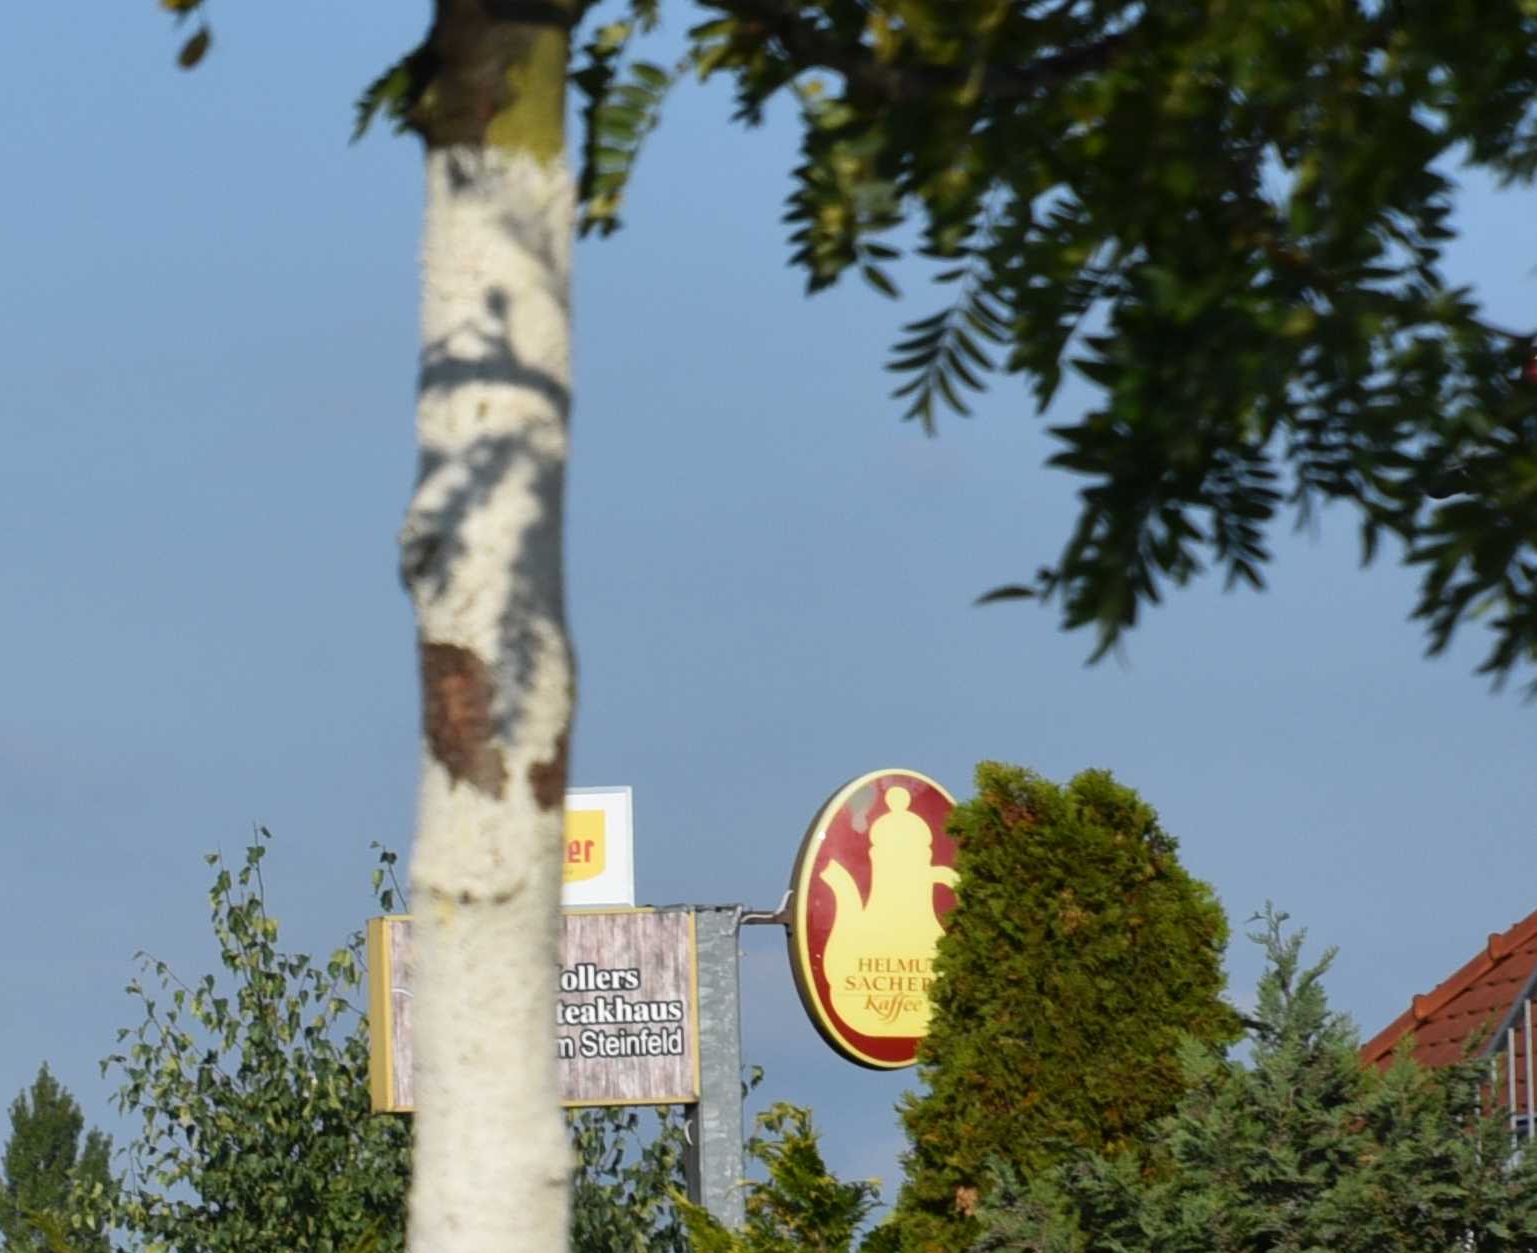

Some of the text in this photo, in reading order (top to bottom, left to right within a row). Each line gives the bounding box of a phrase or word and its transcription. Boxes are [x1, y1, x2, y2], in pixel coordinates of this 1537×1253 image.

[567, 839, 595, 864] er
[560, 964, 640, 991] ollers
[557, 997, 684, 1025] teakhaus
[863, 992, 923, 1025] Kaffee
[558, 1027, 684, 1057] m Steinfeld
